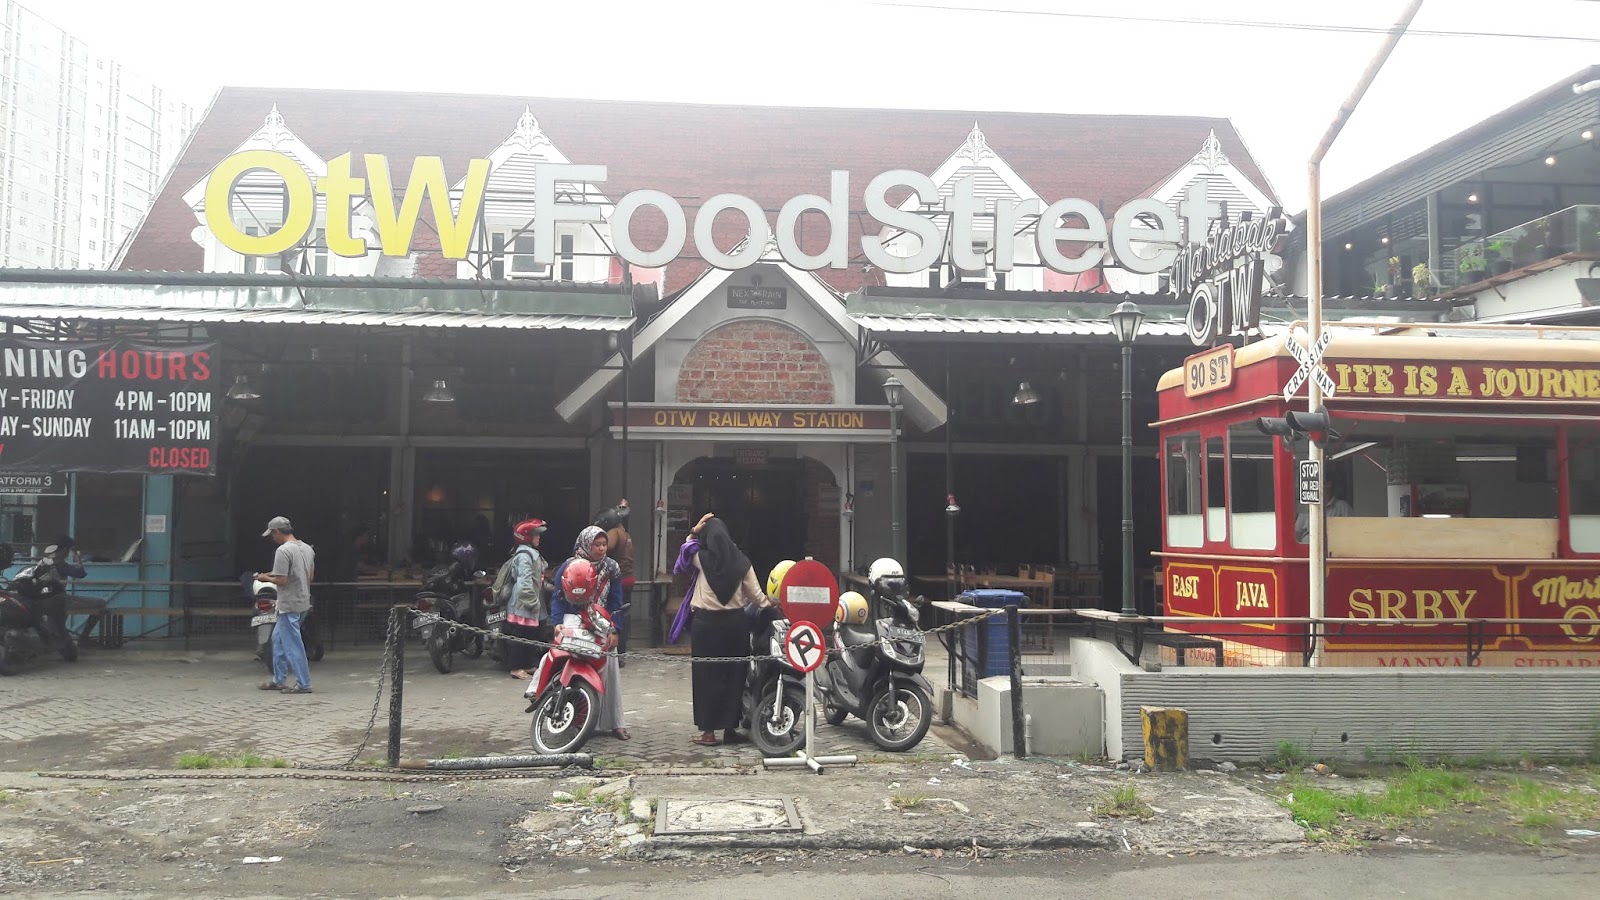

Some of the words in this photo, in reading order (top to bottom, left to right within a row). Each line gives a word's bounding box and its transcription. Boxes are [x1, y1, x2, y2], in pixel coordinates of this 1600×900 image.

[205, 149, 490, 259] OtW
[534, 163, 1220, 274] FoodStreet
[1167, 207, 1289, 300] Martabak
[1186, 259, 1263, 346] OTW
[0, 348, 87, 379] NING
[98, 350, 211, 381] HOURS
[1191, 361, 1206, 390] 90
[1209, 354, 1229, 386] ST
[1287, 331, 1329, 395] CROSSING
[1287, 336, 1303, 361] RAIL
[1316, 369, 1333, 394] WAY
[1403, 365, 1438, 396] IS
[1447, 366, 1472, 397] A
[169, 391, 211, 412] 10PM
[32, 417, 92, 438] SUNDAY
[114, 418, 155, 439] 11AM
[169, 419, 211, 440] 10PM
[654, 410, 697, 426] OTW
[708, 411, 782, 427] RAILWAY
[793, 411, 864, 428] STATION
[149, 446, 210, 468] CLOSED
[1301, 463, 1319, 478] STOP
[44, 476, 52, 486] 3
[1301, 480, 1309, 490] ON
[1309, 480, 1319, 490] RED
[1301, 490, 1319, 501] SIGNAL
[1172, 574, 1200, 600] EAST
[1235, 580, 1269, 611] JAVA
[1348, 588, 1477, 627] SRBY
